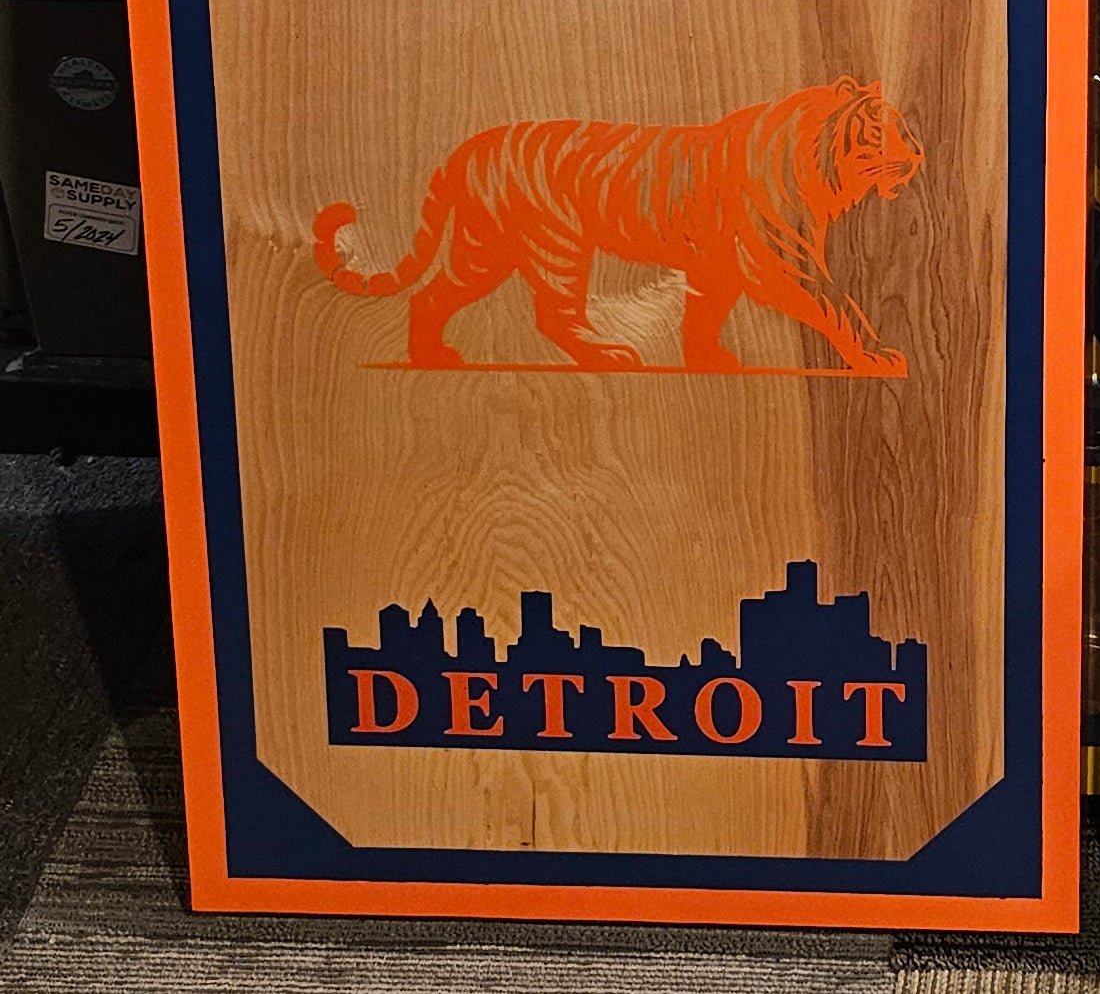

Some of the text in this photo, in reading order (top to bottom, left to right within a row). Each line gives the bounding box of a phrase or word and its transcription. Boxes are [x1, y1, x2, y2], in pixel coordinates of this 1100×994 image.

[67, 189, 137, 211] SUPPLY
[52, 218, 126, 246] 5/2024
[347, 669, 905, 747] DETROIT
